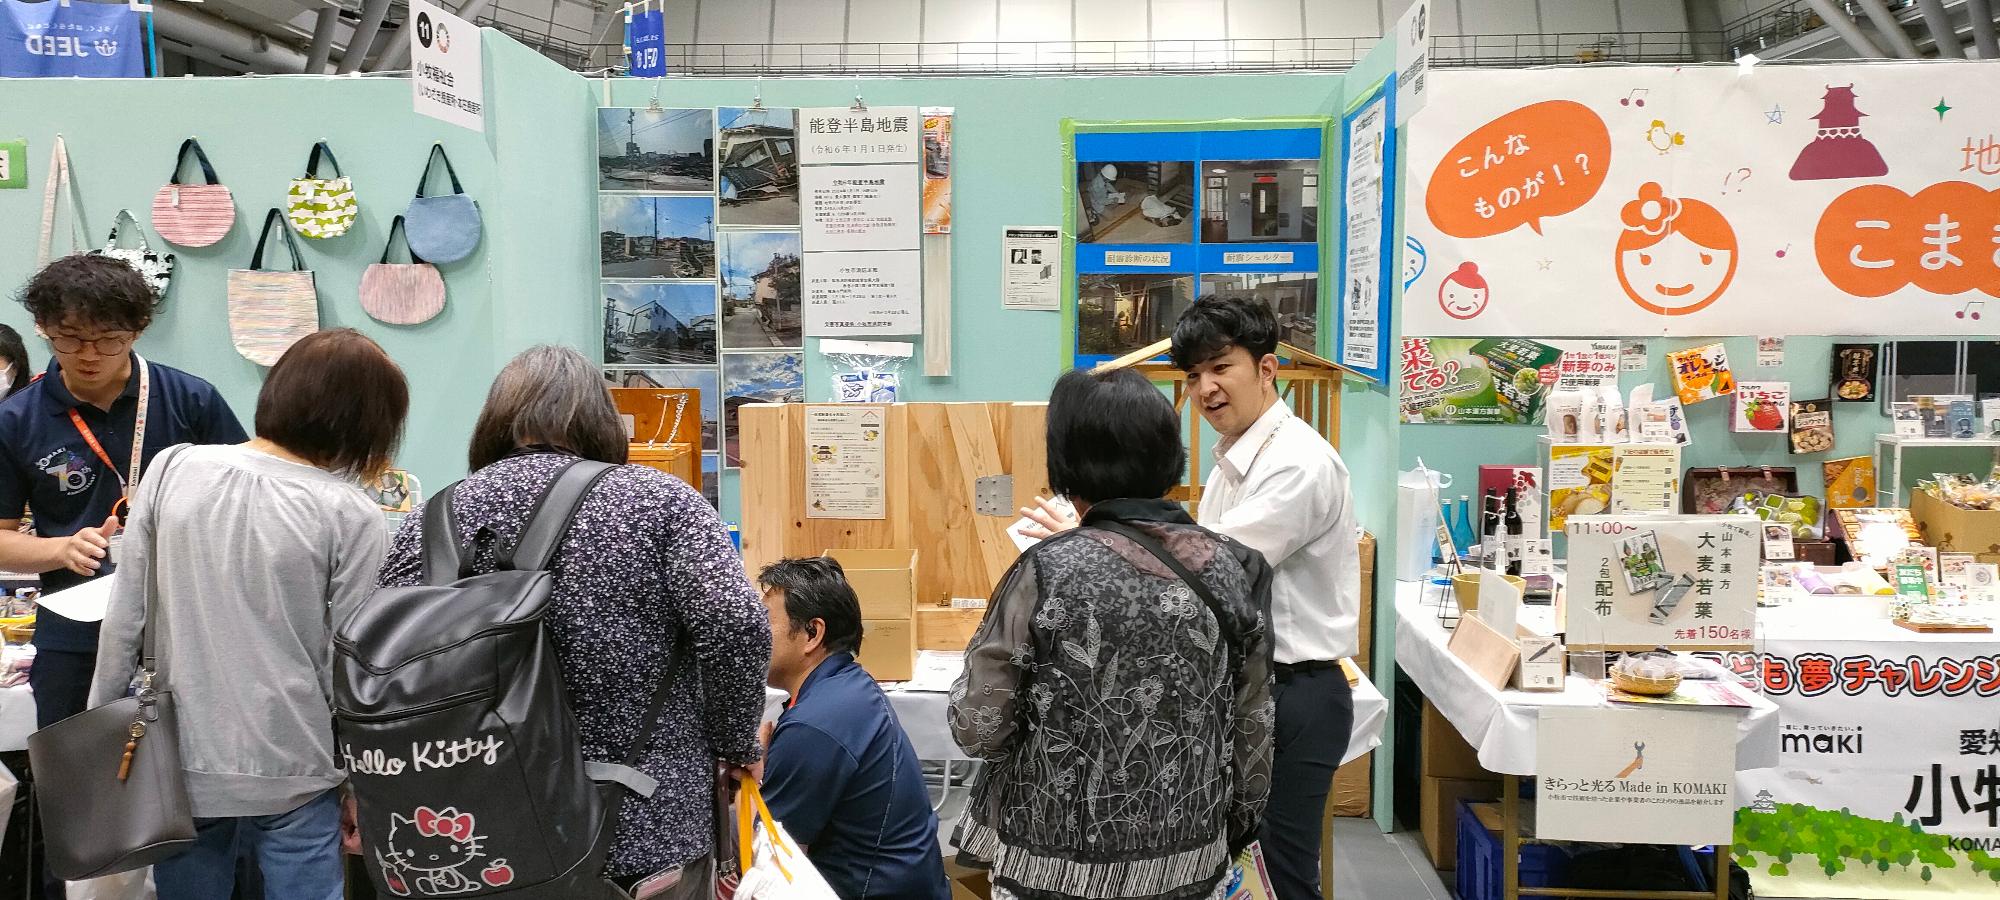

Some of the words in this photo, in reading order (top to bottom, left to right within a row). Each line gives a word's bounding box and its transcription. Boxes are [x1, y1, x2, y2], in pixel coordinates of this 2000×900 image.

[419, 21, 430, 40] 11
[809, 117, 908, 134] 能登半島地震
[1456, 133, 1531, 178] こんな
[1960, 134, 2000, 175] 地
[1474, 152, 1591, 219] ものが！？
[1106, 254, 1169, 265] 耐震診断の状況
[1226, 253, 1290, 263] 耐震シェルター
[1562, 360, 1616, 373] 新芽のみ
[1677, 353, 1725, 374] オレンジ
[1400, 359, 1461, 394] てる？
[1740, 391, 1788, 400] いちご
[1720, 531, 1733, 590] 山本漢方
[1694, 531, 1715, 619] 大麦若葉
[1674, 625, 1753, 640] 先着150名様
[1694, 655, 2000, 694] ども夢チャレンジ
[1781, 726, 1862, 754] maki
[412, 735, 504, 772] Kitty
[1544, 777, 1616, 792] きらっと光る
[1619, 781, 1651, 793] Made
[1656, 782, 1668, 794] in
[1673, 783, 1728, 795] KOMAKI
